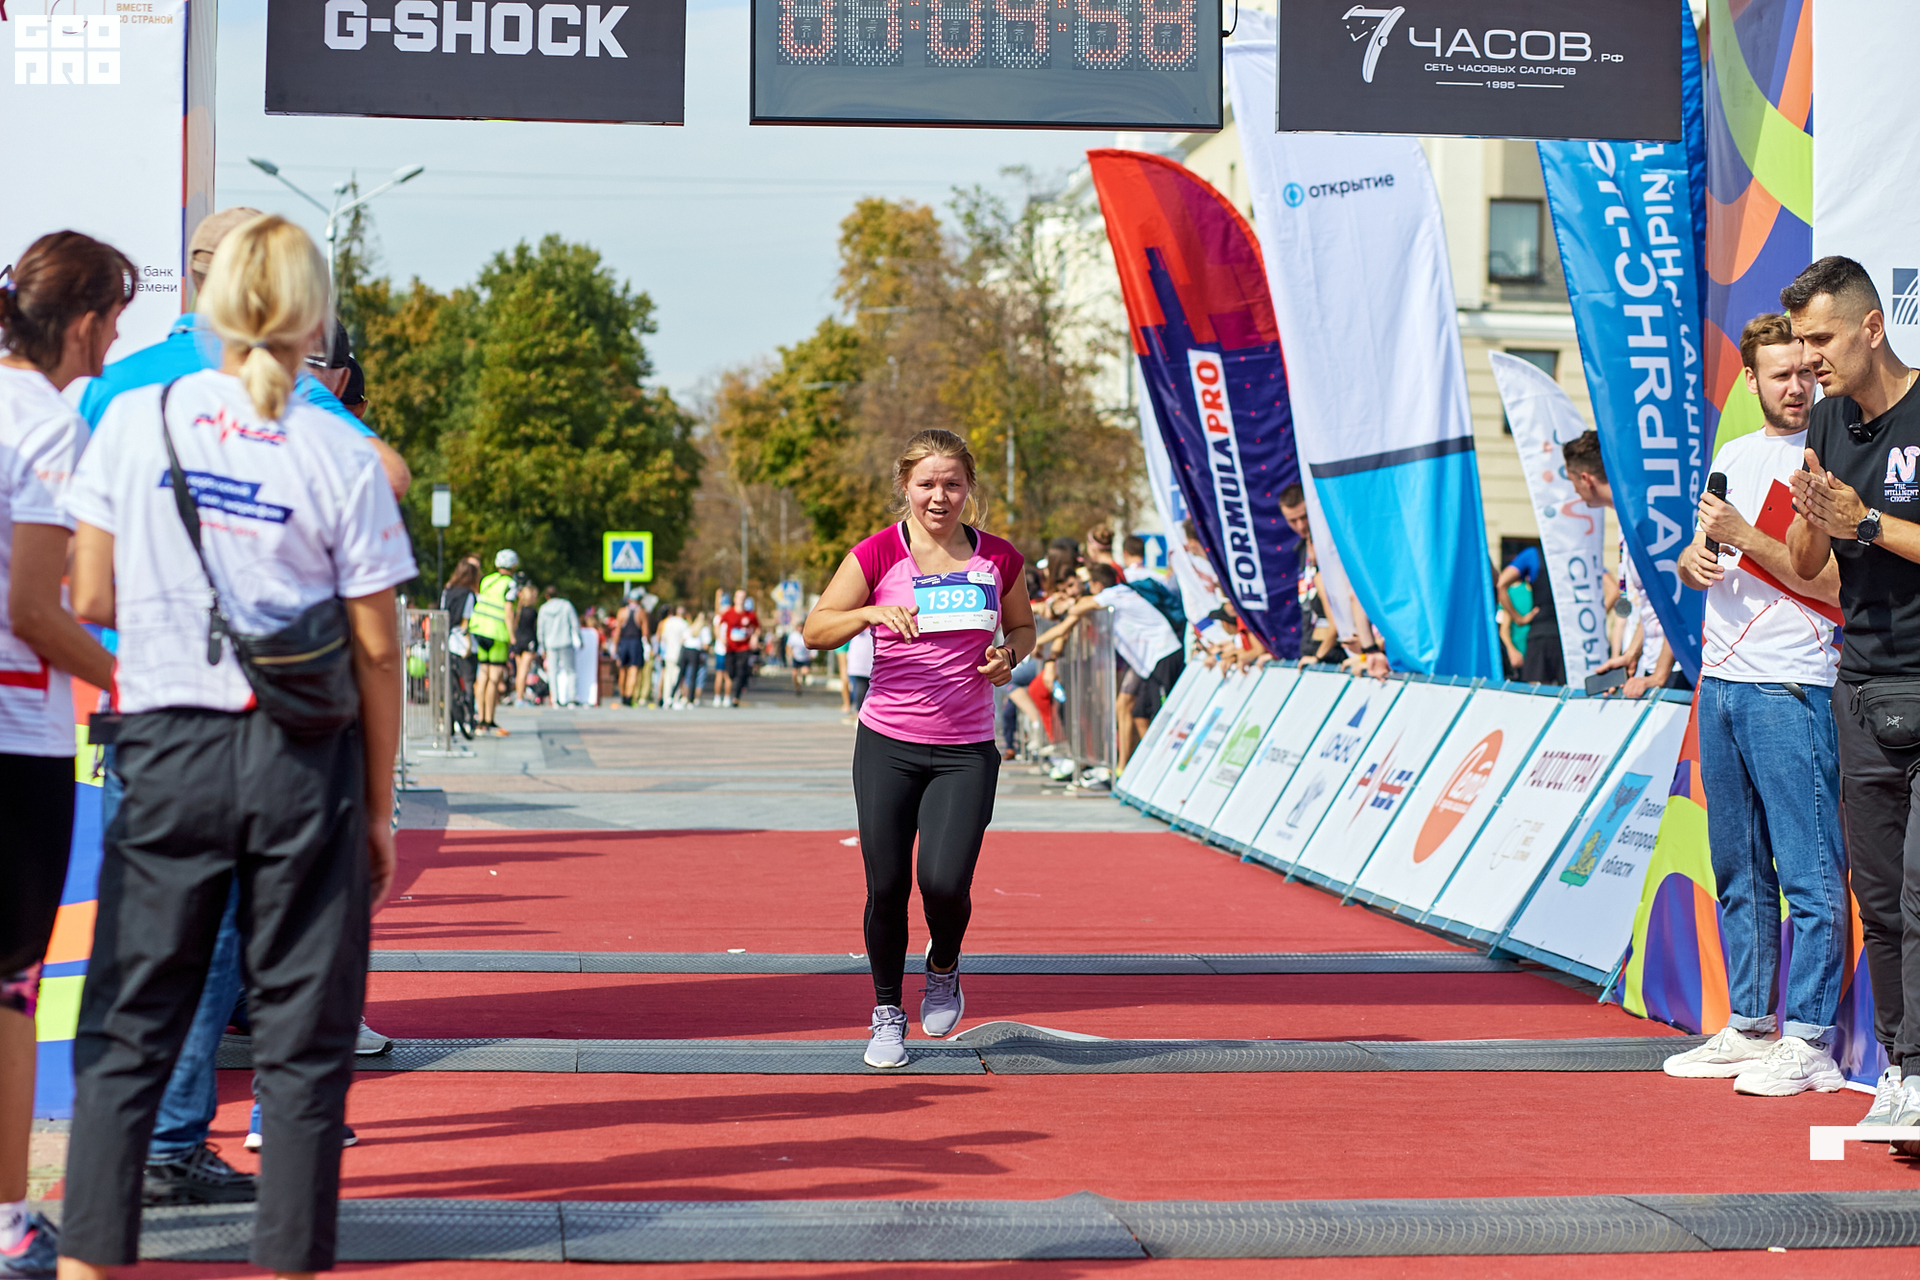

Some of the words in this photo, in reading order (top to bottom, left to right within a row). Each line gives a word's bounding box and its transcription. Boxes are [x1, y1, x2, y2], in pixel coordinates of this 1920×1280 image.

[116, 3, 153, 12] ВМЕСТЕ
[131, 14, 173, 25] СТРАНОЙ
[324, 0, 630, 59] G-SHOCK
[1341, 4, 1406, 84] 7
[1424, 63, 1454, 72] СЕТЬ
[1457, 64, 1516, 74] ЧАСОВЫХ
[1519, 66, 1577, 76] САЛОНОВ
[1485, 80, 1515, 89] 1995
[1308, 173, 1395, 198] открытие
[143, 265, 174, 277] банк
[123, 283, 178, 293] вемени
[927, 588, 978, 611] 1393
[1617, 824, 1659, 852] Белгород
[1600, 854, 1636, 878] области
